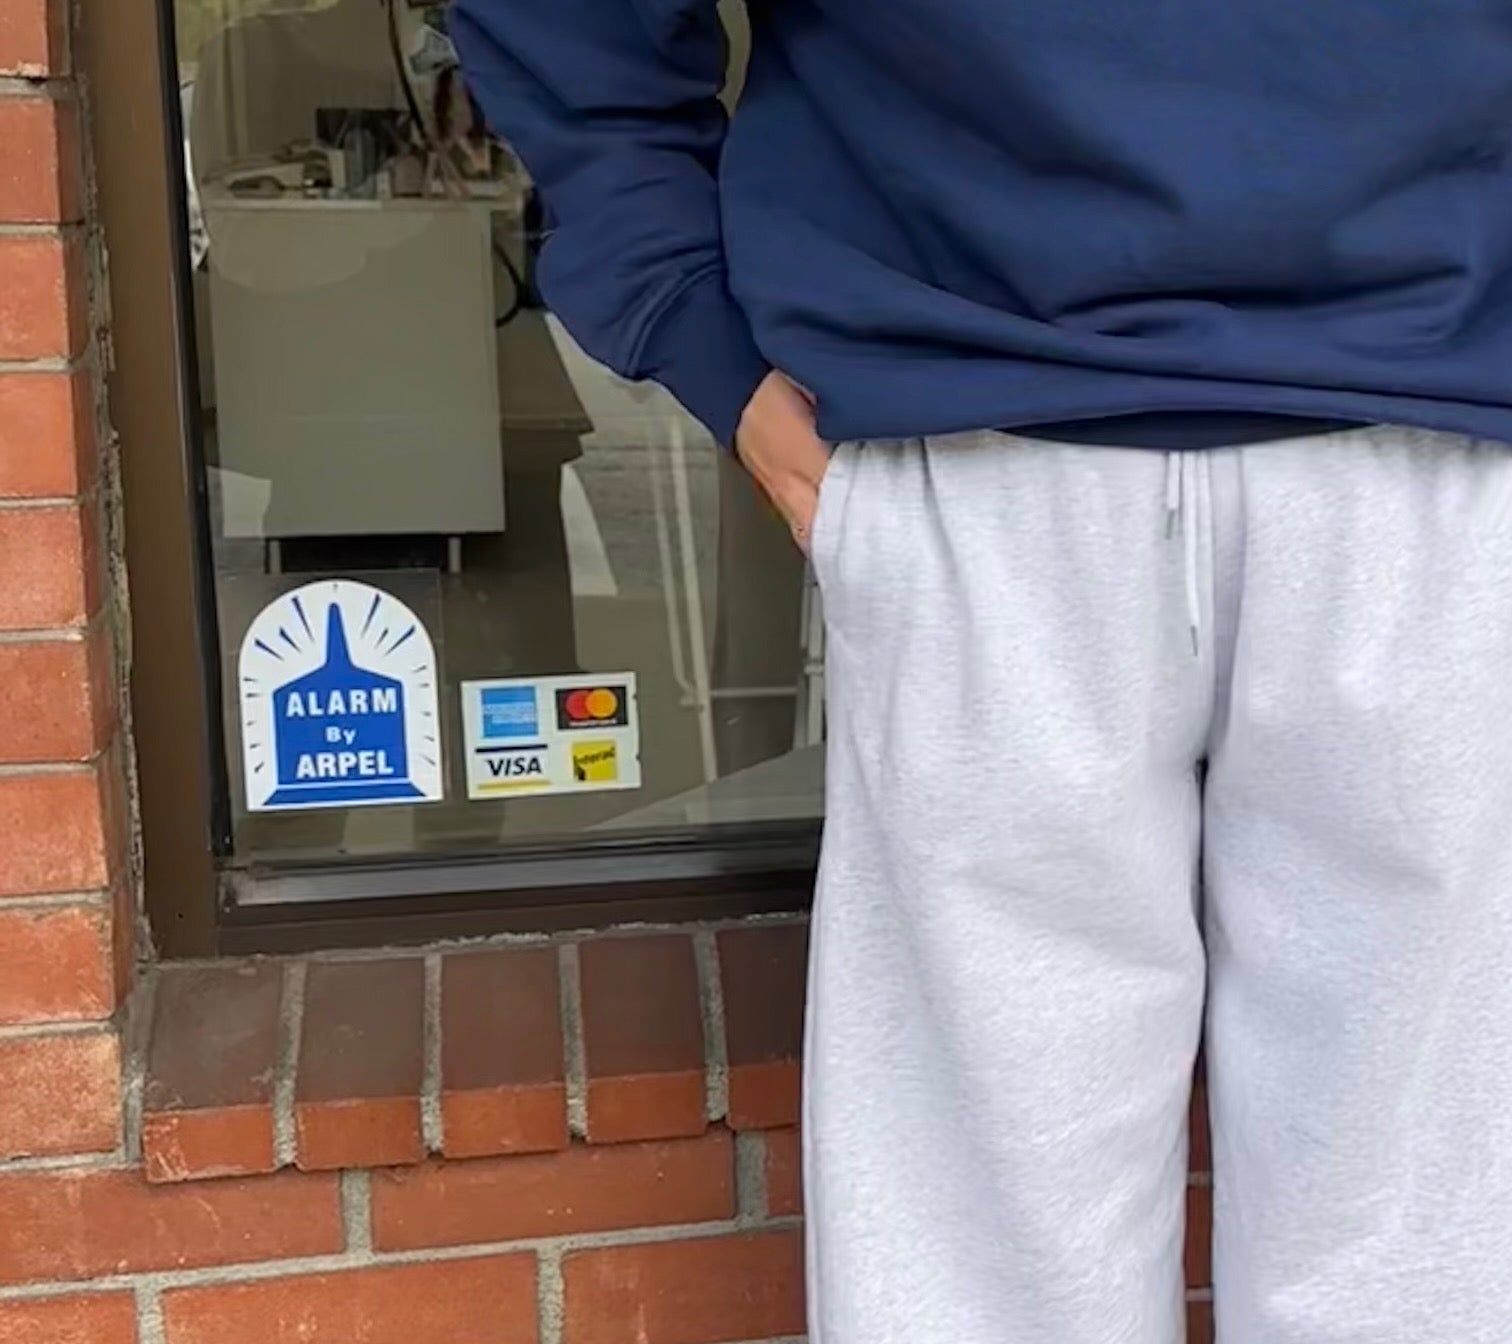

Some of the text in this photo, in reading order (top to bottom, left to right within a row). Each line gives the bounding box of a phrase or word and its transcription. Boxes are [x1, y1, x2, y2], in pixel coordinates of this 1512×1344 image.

[285, 686, 398, 718] ALARM
[326, 726, 356, 746] By
[294, 750, 395, 781] ARPEL
[485, 755, 543, 777] VISA
